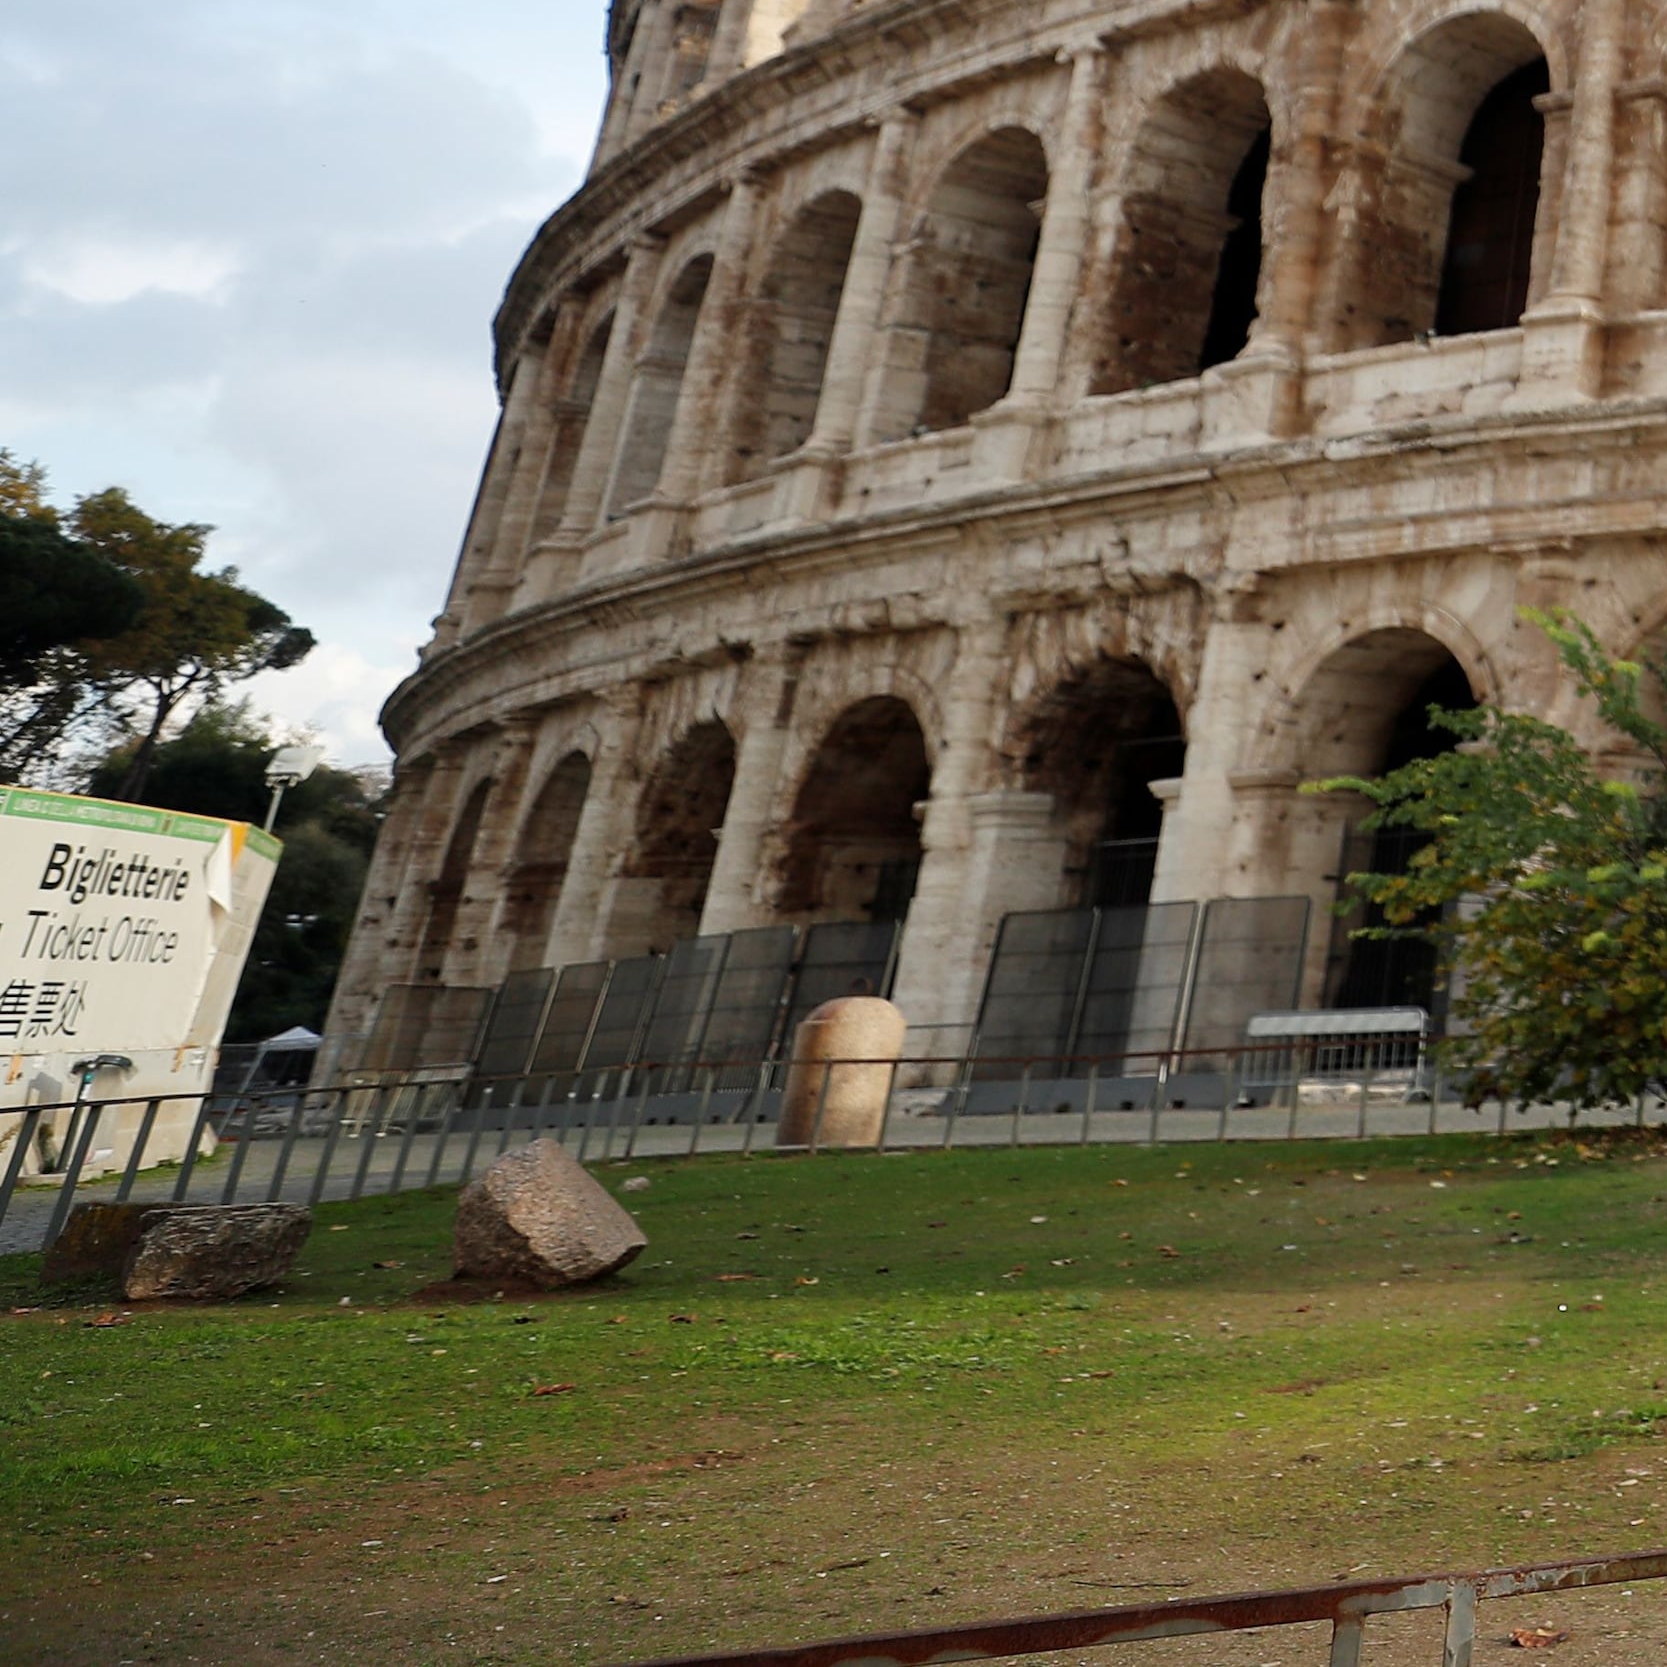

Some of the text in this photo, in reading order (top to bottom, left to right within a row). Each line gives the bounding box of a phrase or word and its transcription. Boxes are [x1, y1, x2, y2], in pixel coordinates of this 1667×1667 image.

[39, 842, 190, 905] Biglietterie
[20, 910, 179, 964] Ticket Office
